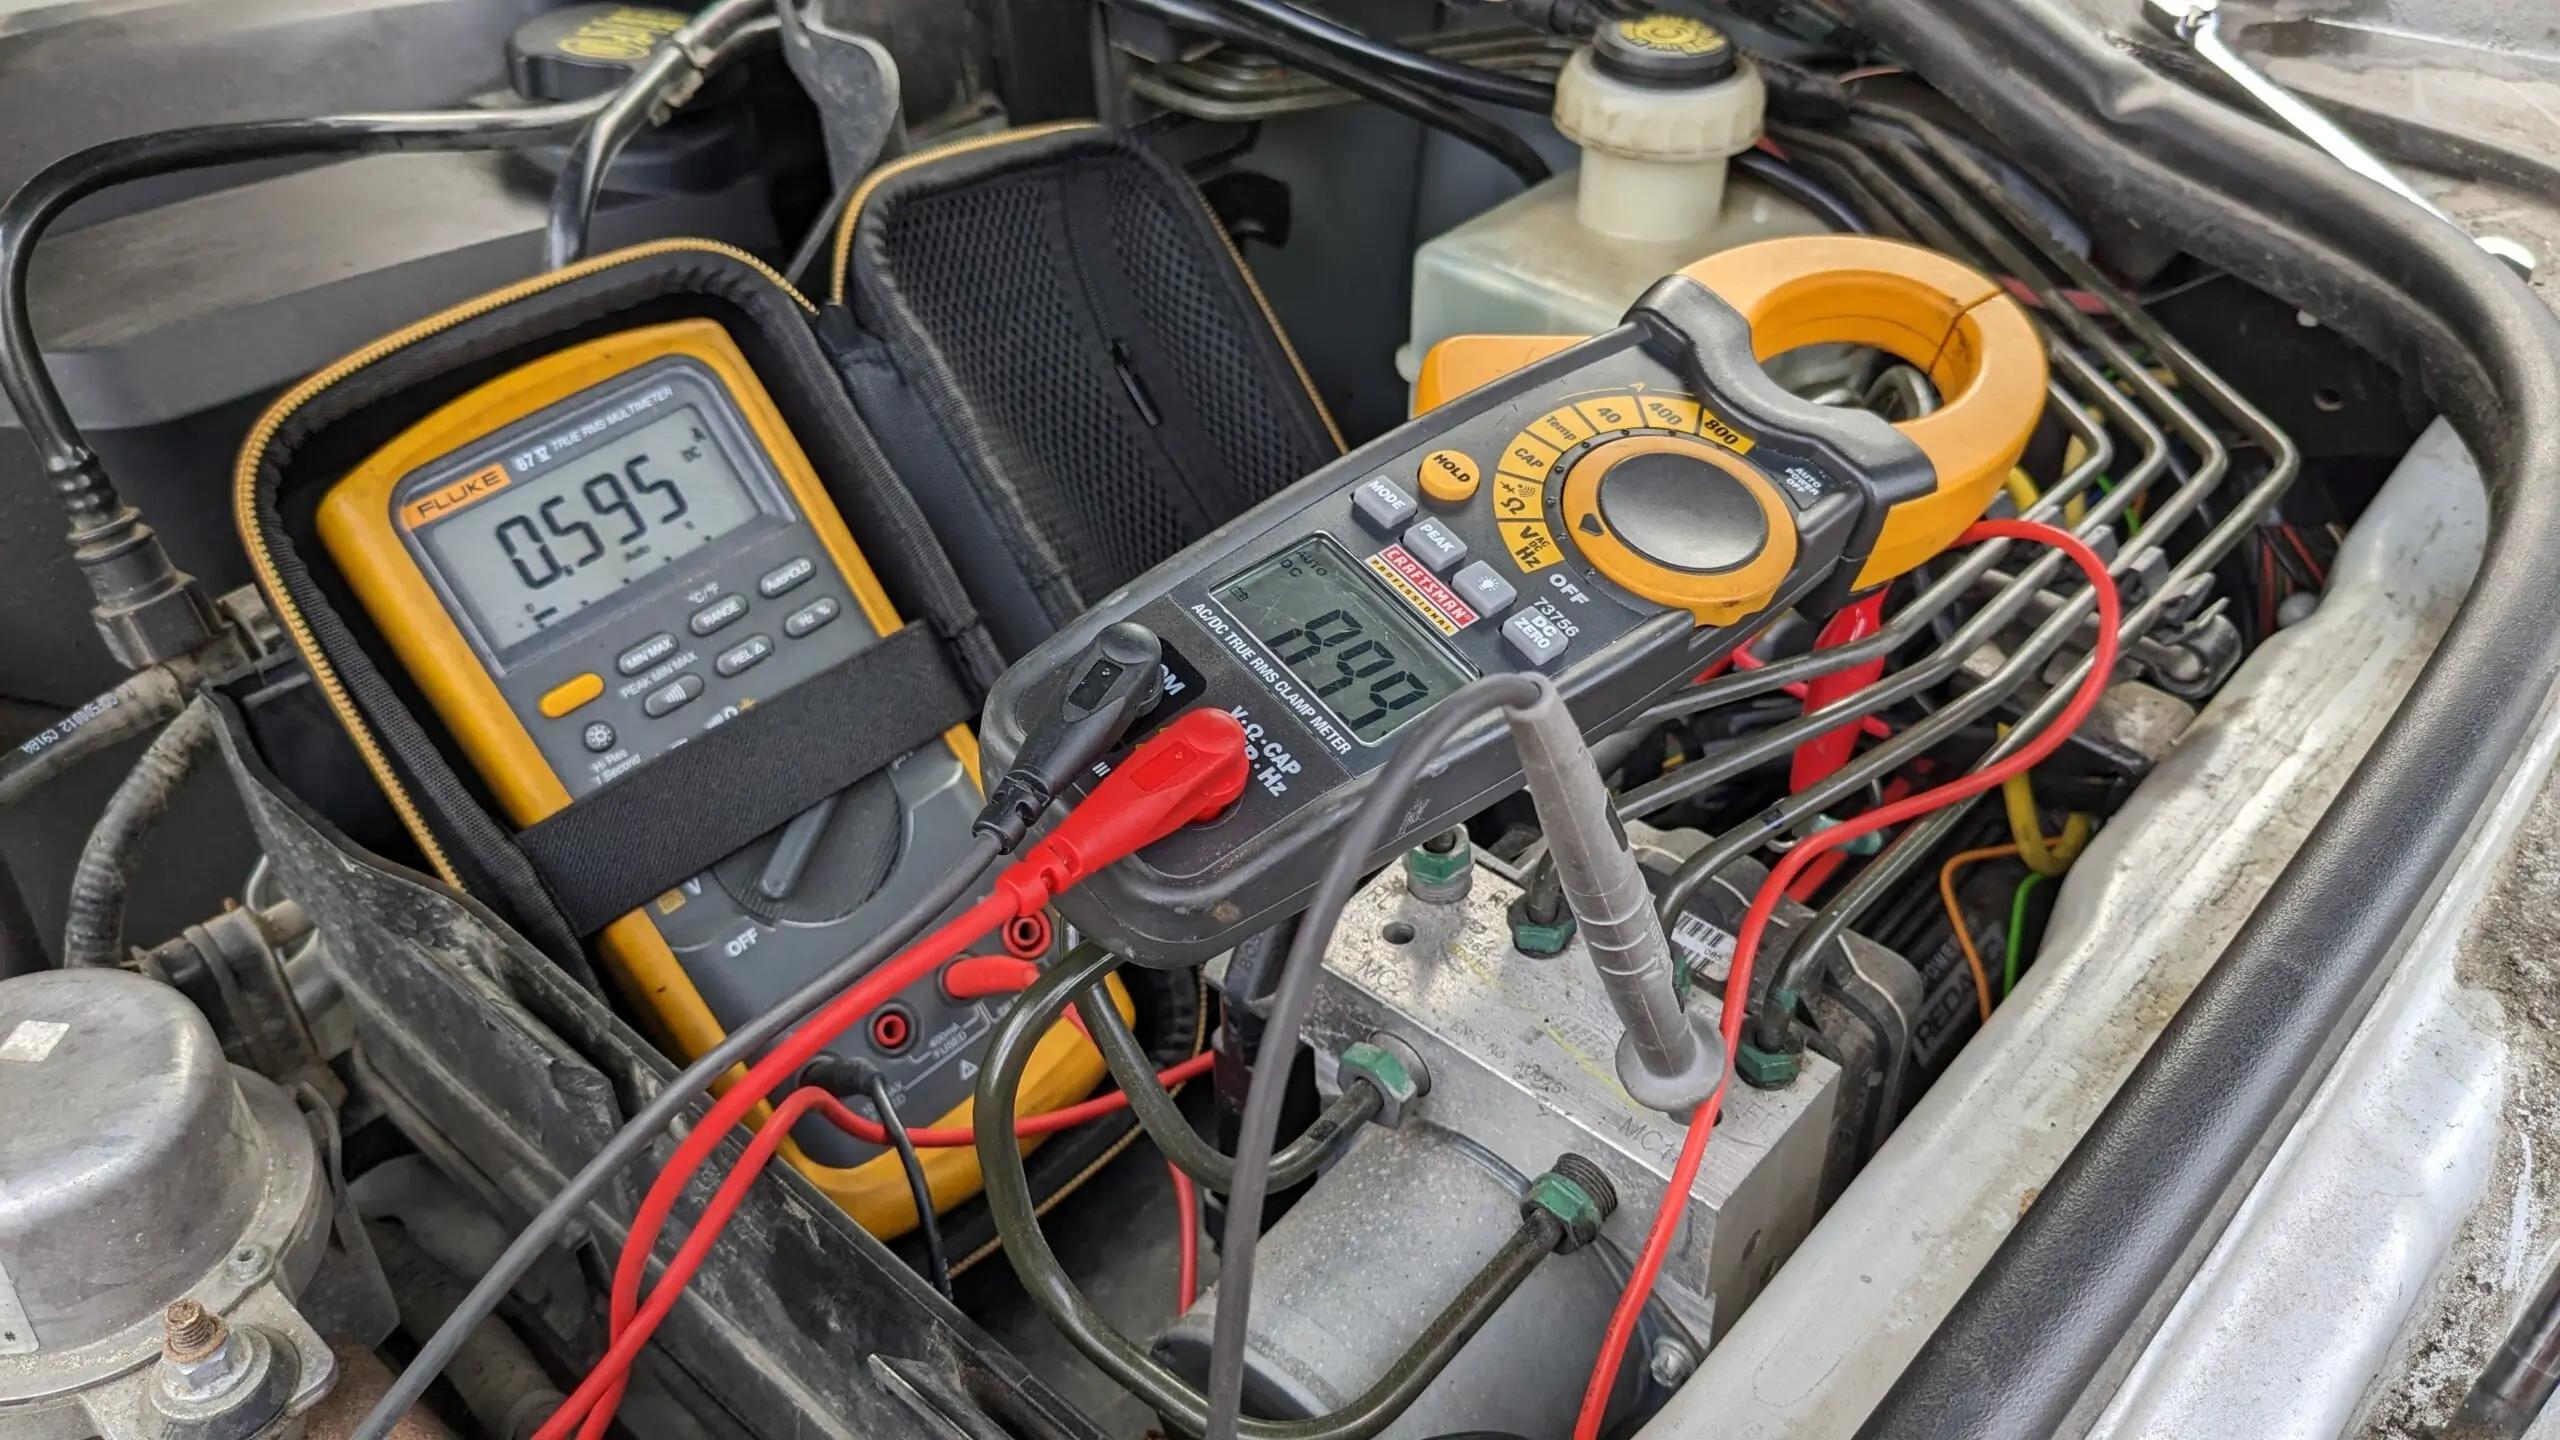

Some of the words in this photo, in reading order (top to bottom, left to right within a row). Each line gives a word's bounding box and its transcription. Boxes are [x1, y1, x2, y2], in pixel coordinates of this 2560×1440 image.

[550, 429, 583, 453] TRUE
[580, 416, 608, 442] RMS
[604, 386, 675, 429] MULTIMETER
[1597, 406, 1622, 424] 40
[1649, 401, 1683, 427] 400
[1545, 415, 1578, 443] Temp
[1702, 418, 1740, 446] 800
[679, 444, 703, 463] DC
[1513, 445, 1545, 471] CAP
[1432, 452, 1472, 485] HOLD
[1784, 467, 1819, 496] POWER
[1794, 467, 1821, 488] AUTO
[415, 469, 503, 519] FLUKE
[1369, 480, 1406, 511] MODE
[1786, 478, 1806, 493] OFF
[1500, 496, 1526, 516] Ω
[1420, 523, 1455, 552] PEAK
[1518, 525, 1537, 543] V
[1535, 535, 1550, 549] AC
[1527, 539, 1543, 555] DC
[1279, 558, 1303, 578] DC
[1296, 551, 1329, 577] AUTO
[1516, 544, 1542, 571] Hz
[1369, 556, 1456, 634] PROFESSIONAL
[1548, 571, 1590, 607] OFF
[701, 600, 741, 627] RANGE
[798, 612, 815, 627] Hz
[1530, 616, 1557, 639] DC
[1533, 596, 1580, 637] 73756
[1513, 620, 1552, 650] ZERO
[625, 648, 650, 669] MIN
[648, 637, 674, 659] MAX
[729, 650, 754, 668] REL
[618, 676, 653, 700] PEAK
[651, 663, 674, 683] MIN
[671, 649, 699, 672] MAX
[1191, 602, 1228, 635] AC/DC
[1223, 629, 1255, 661] TRUE
[1251, 655, 1281, 686] RMS
[1273, 678, 1317, 724] CLAMP
[1312, 715, 1354, 756] METER
[1264, 607, 1430, 732] 899
[600, 753, 643, 783] Second
[723, 926, 758, 957] OFF
[1356, 950, 1412, 1002] MC2
[1913, 932, 2005, 1048] REDAC
[1616, 1113, 1676, 1162] MC1
